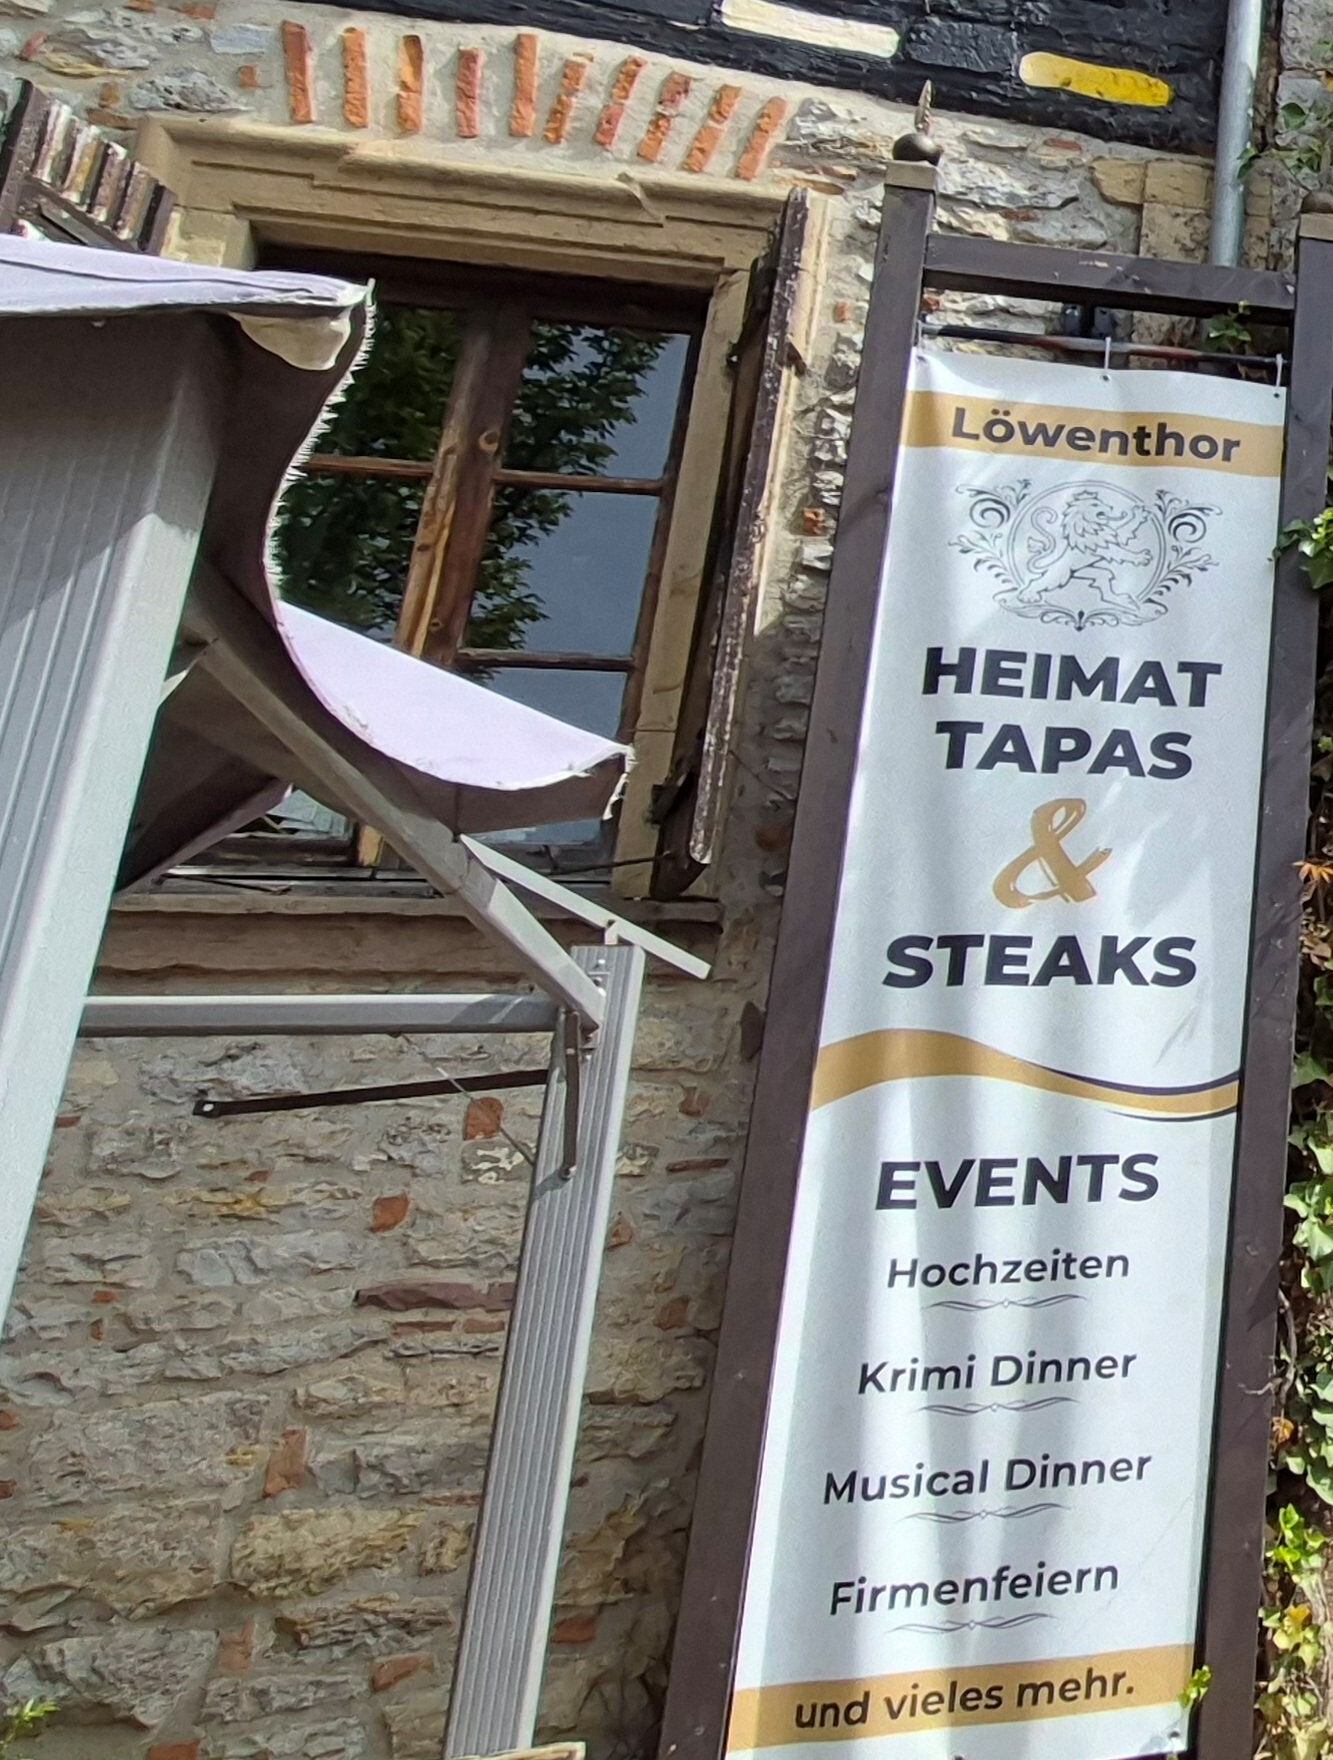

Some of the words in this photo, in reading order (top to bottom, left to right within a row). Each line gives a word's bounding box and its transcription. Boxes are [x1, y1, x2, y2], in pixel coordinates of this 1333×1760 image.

[950, 406, 1242, 463] Löwenthor
[920, 646, 1223, 709] HEIMAT
[935, 720, 1194, 780] TAPAS
[991, 797, 1113, 910] &
[881, 933, 1198, 989] STEAKS
[874, 1152, 1162, 1212] EVENTS
[886, 1247, 1131, 1290] Hochzeiten
[857, 1353, 976, 1395] Krimi
[991, 1348, 1139, 1387] Dinner
[822, 1458, 990, 1506] Musical
[1004, 1451, 1154, 1491] Dinner
[828, 1559, 1120, 1616] Firmenfeiern
[794, 1690, 871, 1729] und
[883, 1678, 1004, 1721] vieles
[1015, 1666, 1137, 1709] mehr.
